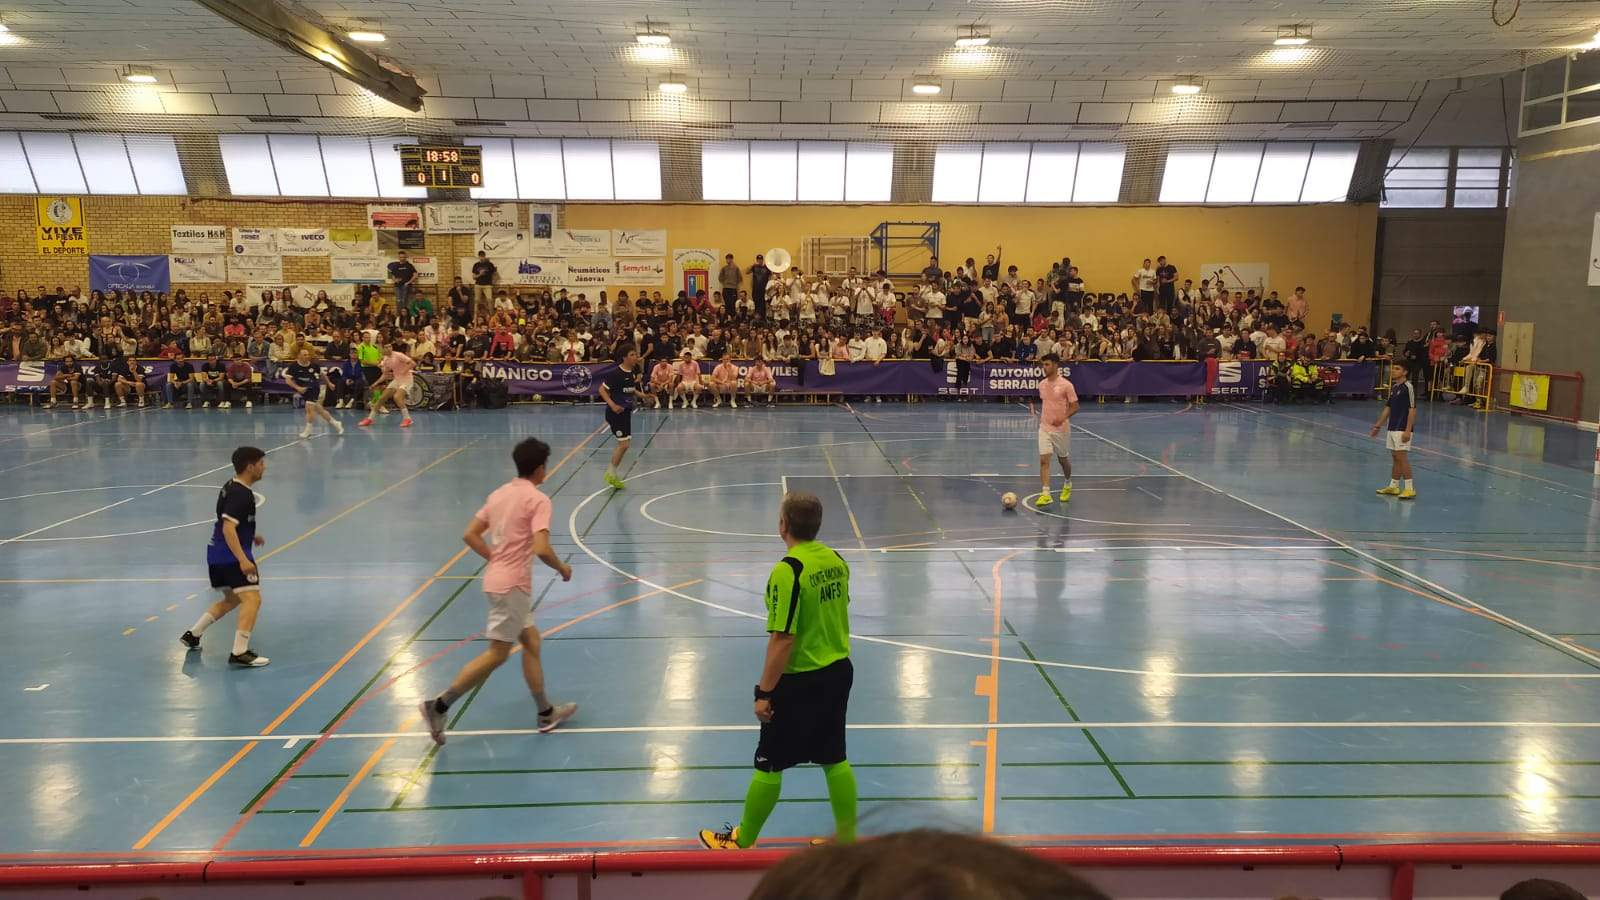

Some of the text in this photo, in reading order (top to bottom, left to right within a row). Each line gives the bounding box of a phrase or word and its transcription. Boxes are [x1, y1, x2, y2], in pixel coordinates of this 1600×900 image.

[427, 151, 458, 162] 18:58
[418, 172, 425, 183] 0
[472, 173, 479, 184] 0
[479, 220, 514, 230] berCaja
[173, 230, 225, 239] Textiles H&H
[568, 265, 610, 273] Neumáticos
[990, 367, 1071, 378] AUTOMÓVES
[990, 379, 1041, 390] SERRABL
[939, 387, 979, 395] SEAT
[1211, 387, 1248, 395] SEAT
